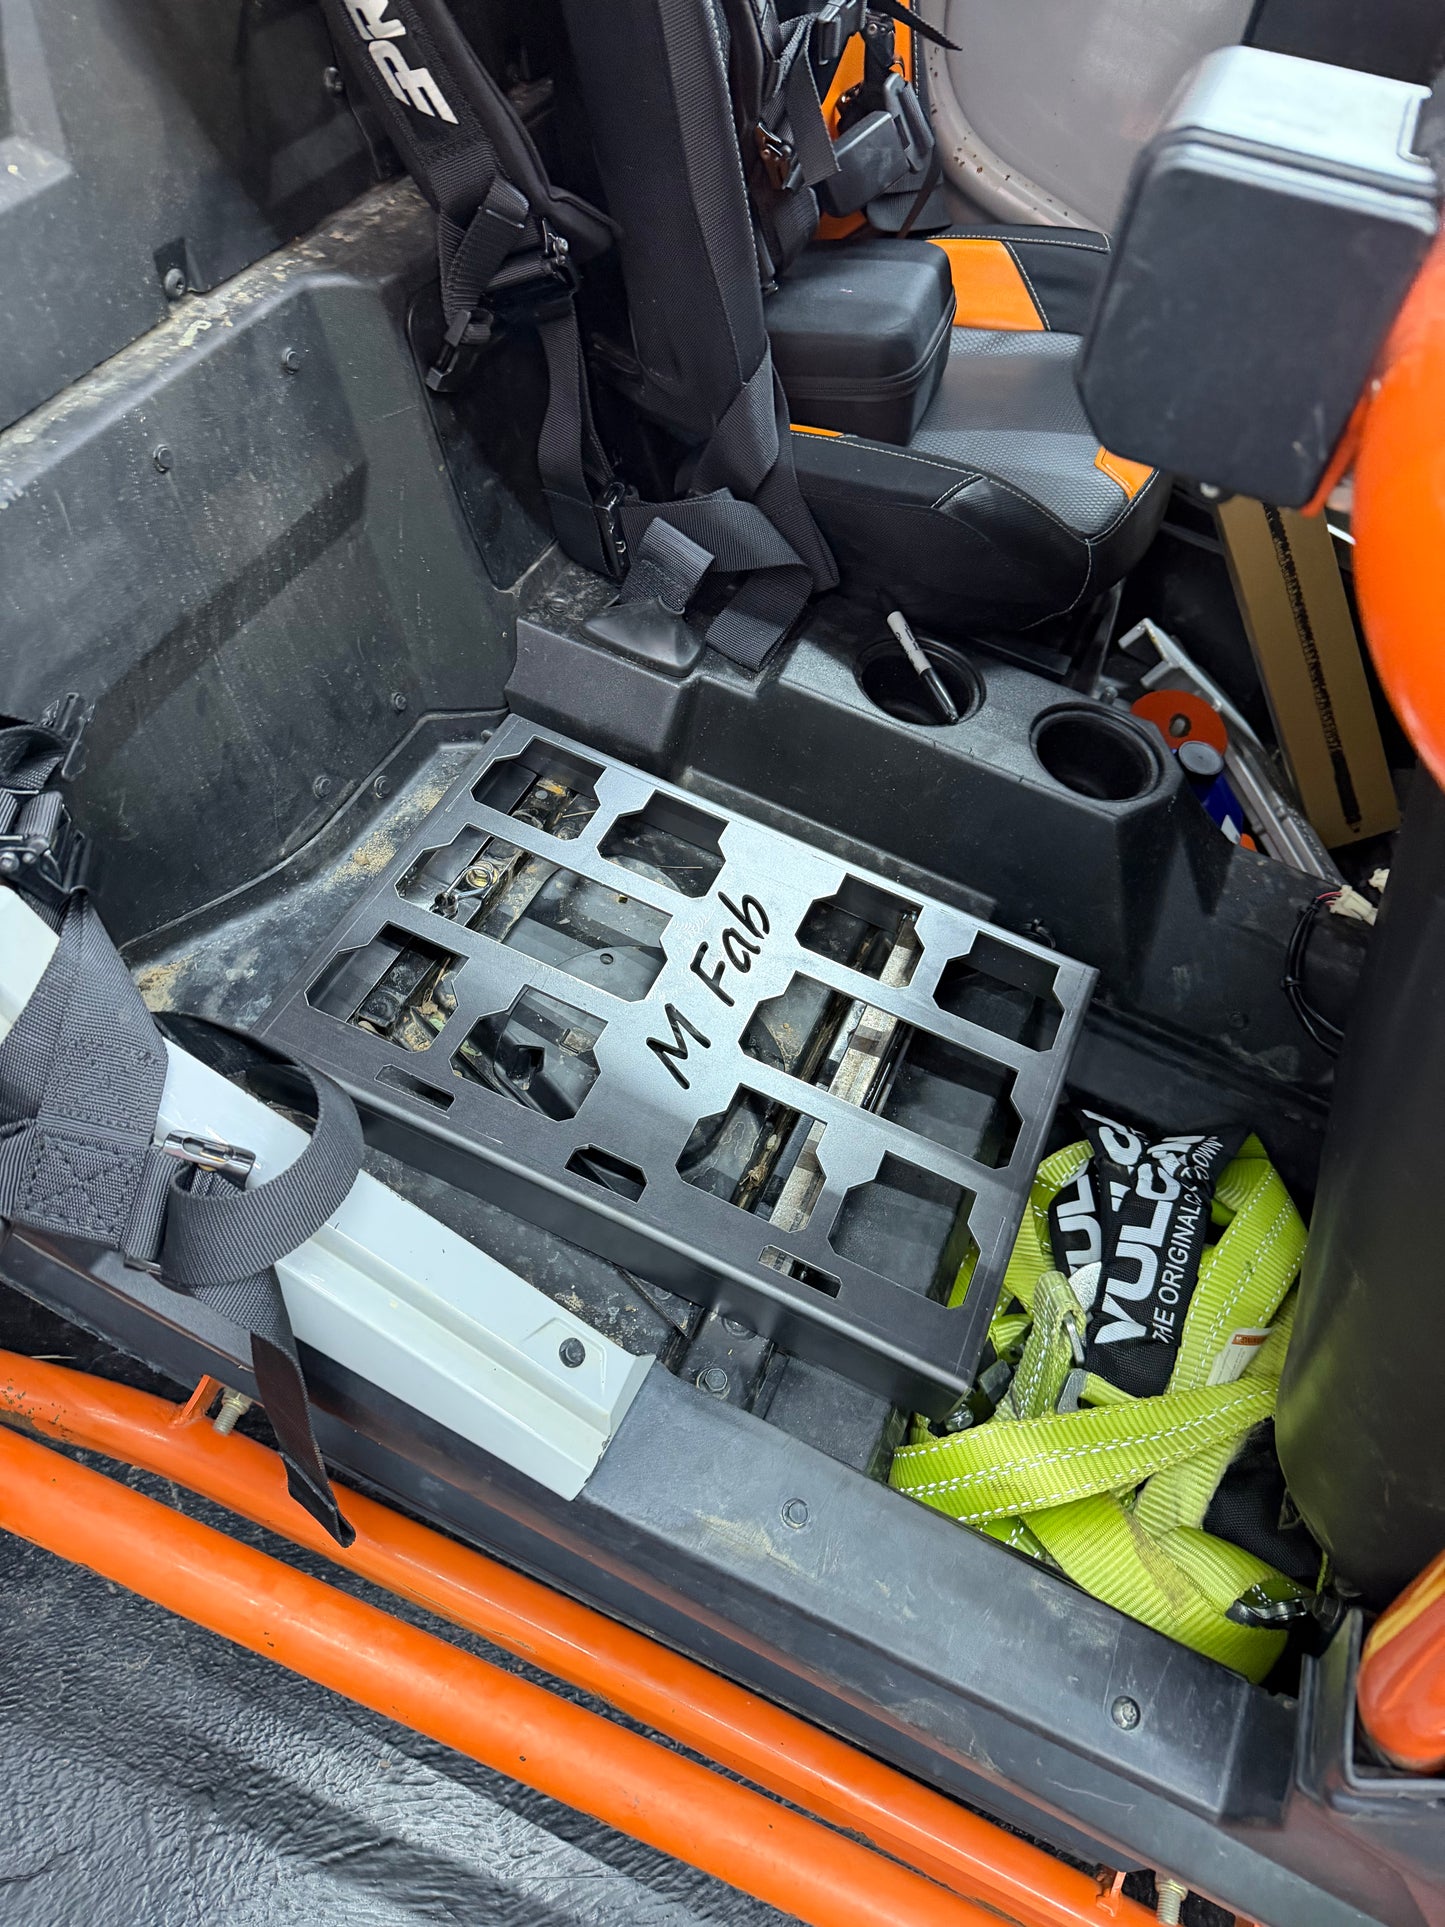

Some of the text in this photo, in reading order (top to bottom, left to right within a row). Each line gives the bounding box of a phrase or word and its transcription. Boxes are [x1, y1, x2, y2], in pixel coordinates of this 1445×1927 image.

[646, 890, 770, 1090] M Fab
[1157, 1205, 1202, 1305] ORIGINAL
[1152, 1306, 1176, 1344] THE
